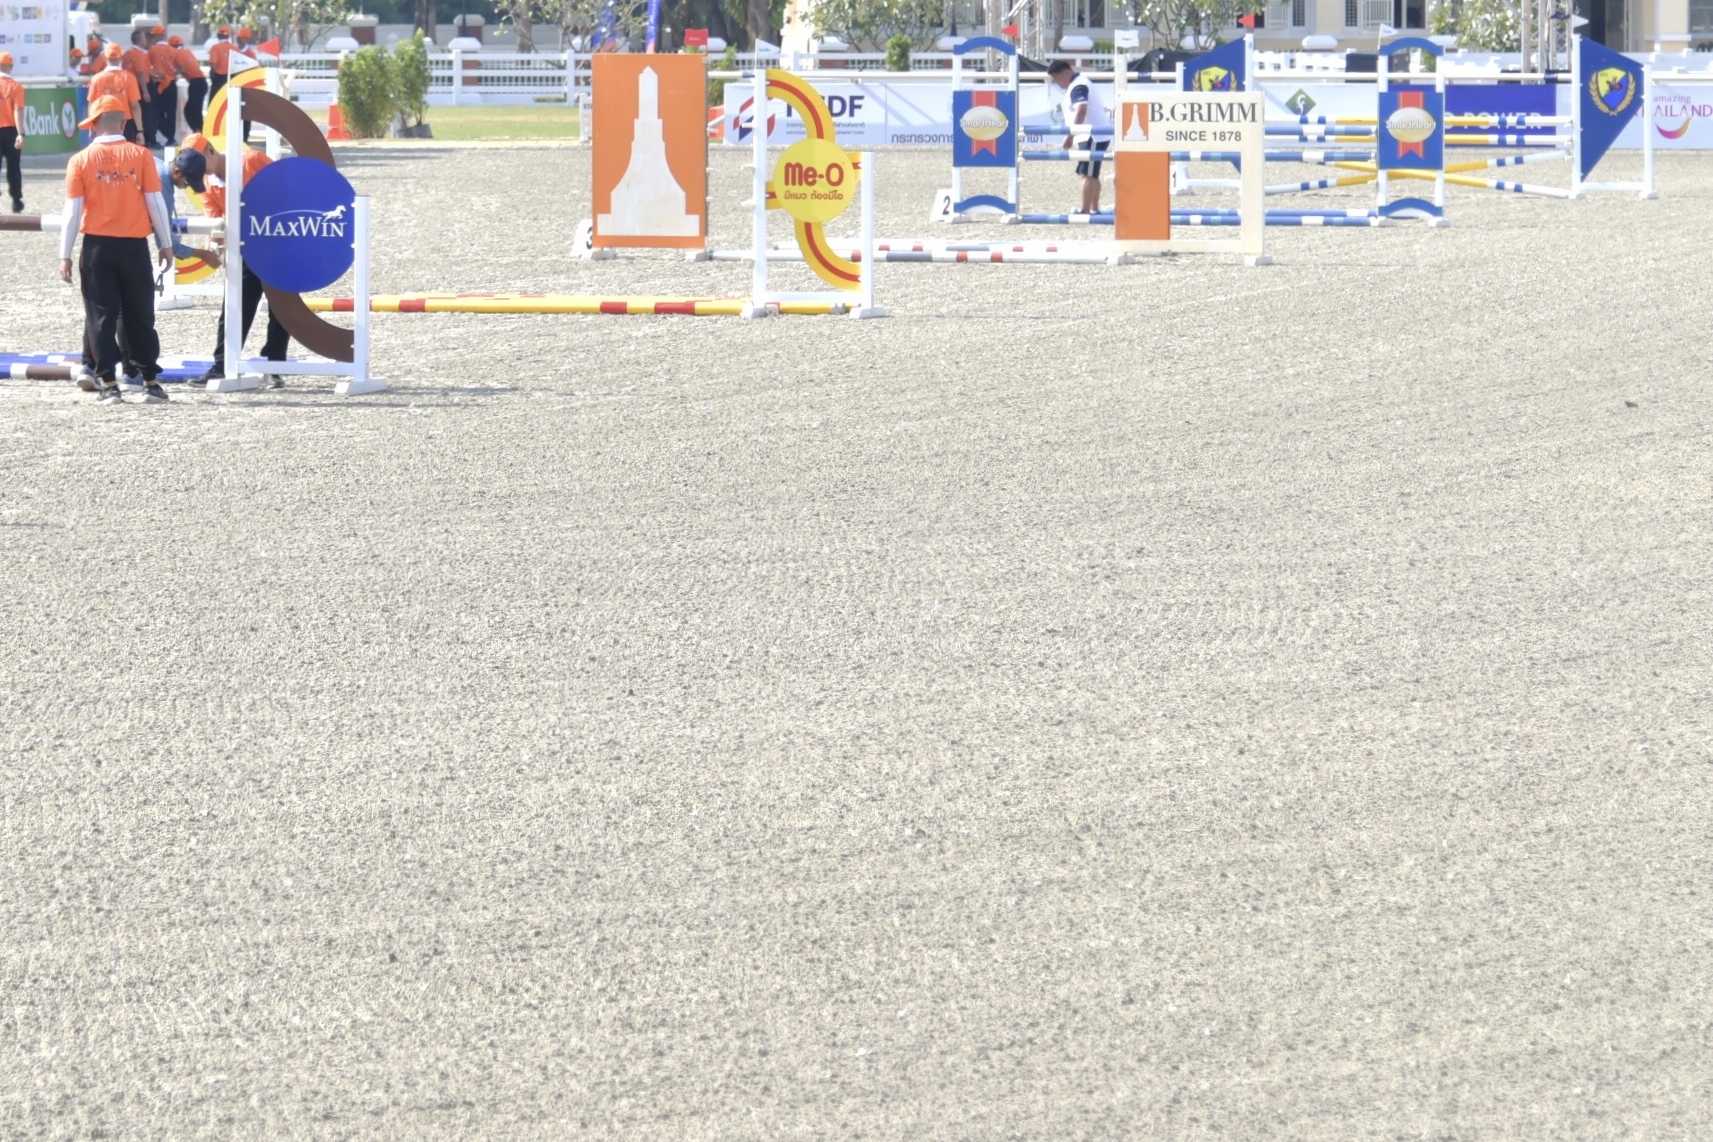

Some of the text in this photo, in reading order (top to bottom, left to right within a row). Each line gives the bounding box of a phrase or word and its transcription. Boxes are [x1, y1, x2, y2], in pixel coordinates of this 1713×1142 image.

[1653, 94, 1692, 104] amazing
[1149, 102, 1258, 123] B.GRIMM
[959, 118, 1010, 129] SmartHeart
[1385, 120, 1437, 130] SmartHeart
[1166, 130, 1242, 142] SINCE 1878
[784, 162, 844, 187] Me-O
[942, 195, 951, 216] 2
